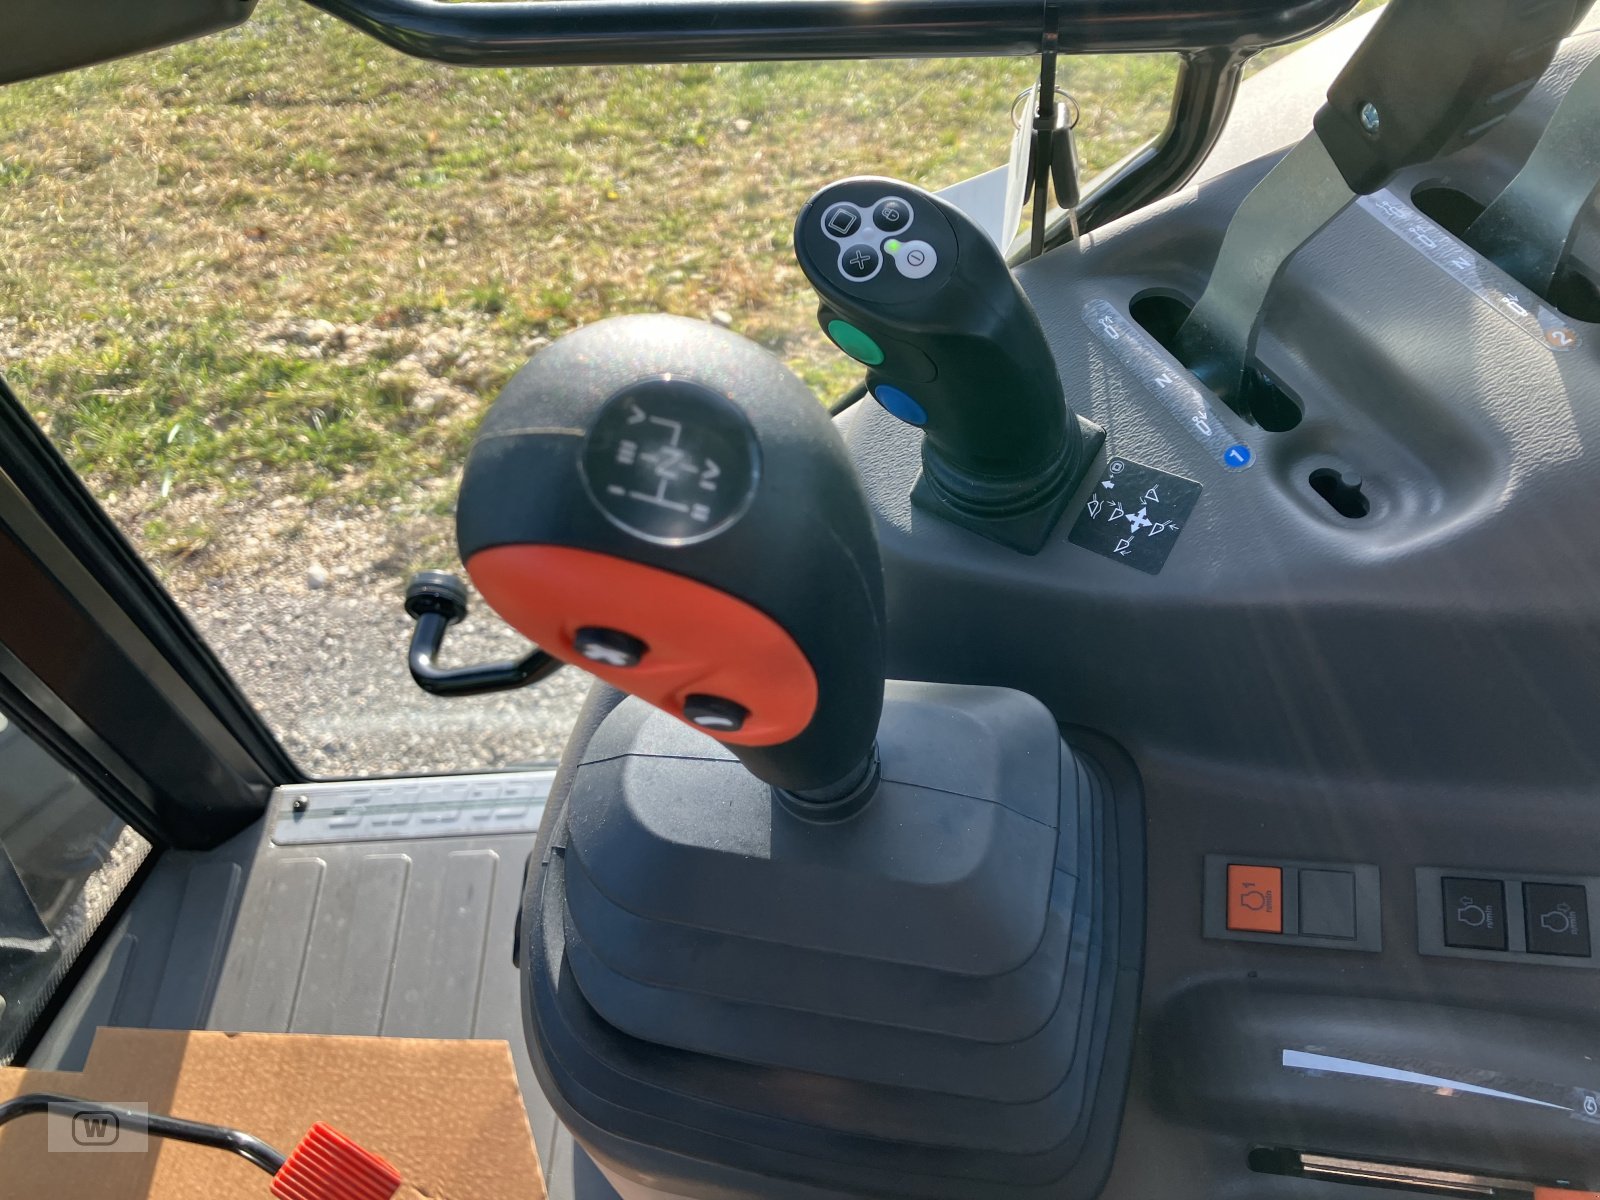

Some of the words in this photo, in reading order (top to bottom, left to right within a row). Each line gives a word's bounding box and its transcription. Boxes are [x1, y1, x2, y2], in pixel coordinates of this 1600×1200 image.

[1551, 331, 1573, 345] 2
[1154, 373, 1173, 389] N
[1229, 449, 1245, 464] 1
